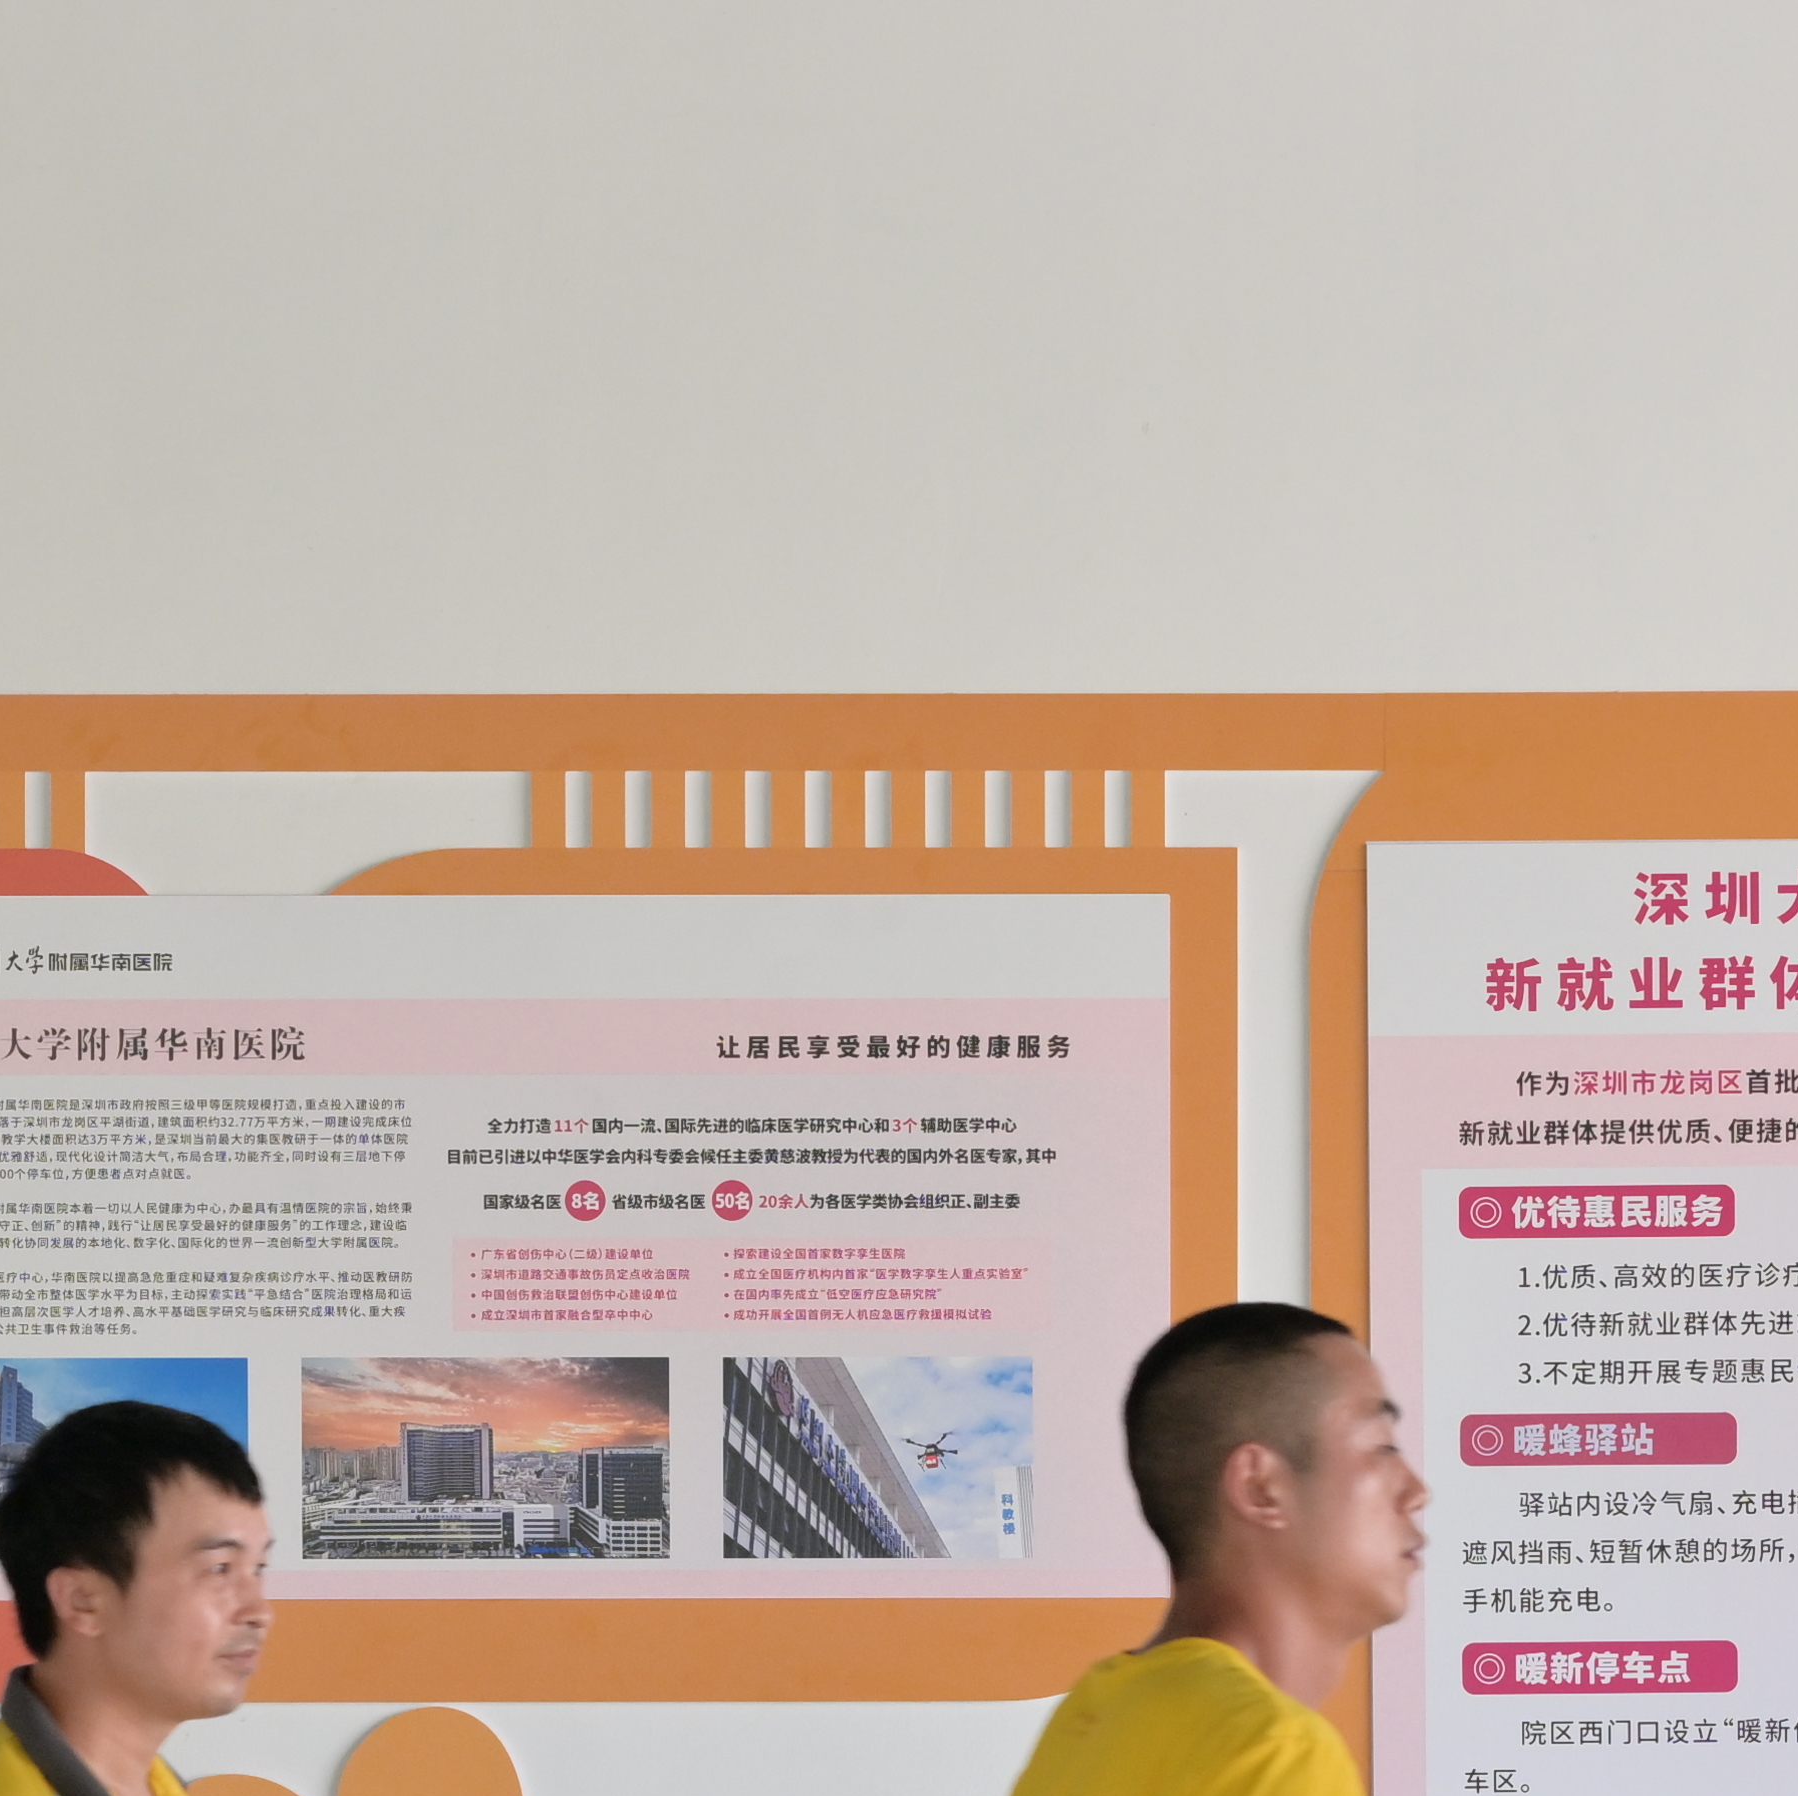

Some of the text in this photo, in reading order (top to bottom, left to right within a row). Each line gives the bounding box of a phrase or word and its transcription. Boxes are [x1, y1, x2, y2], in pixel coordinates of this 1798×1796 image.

[716, 1034, 1070, 1060] 让居民享受最好的健康服务
[447, 1147, 1057, 1165] 目前已引进以中华医学会内科专委会候任主委黄慈波教授为代表的国内外名医专家，其中
[483, 1192, 562, 1210] 国家级名医
[570, 1189, 601, 1212] 8名
[611, 1193, 706, 1210] 省级市级名医
[714, 1189, 751, 1212] 50名
[1510, 1194, 1724, 1229] 优待惠民服务
[481, 1248, 653, 1261] 广东省创伤中心（二级）建设单位
[732, 1247, 906, 1260] 探索建设全国首家数字孪生医院
[480, 1268, 690, 1281] 深圳市道路交通事故伤员定点收治医院
[732, 1267, 1029, 1280] 成立全国医疗机构内首家“医学数字孪生人重点实验室”
[480, 1288, 678, 1301] 中国创伤救治联盟创伤中心建设单位
[732, 1288, 943, 1301] 在国内率先成立“低空医疗应急研究院”
[480, 1308, 653, 1321] 成立深圳市首家融合型卒中中心
[732, 1308, 992, 1321] 成功开展全国首例无人机应急医疗救援模拟试验
[1513, 1422, 1655, 1457] 暖蜂驿站
[1462, 1587, 1613, 1614] 手机能充电。
[1515, 1650, 1691, 1685] 暖新停车点
[1464, 1768, 1530, 1794] 车区。
